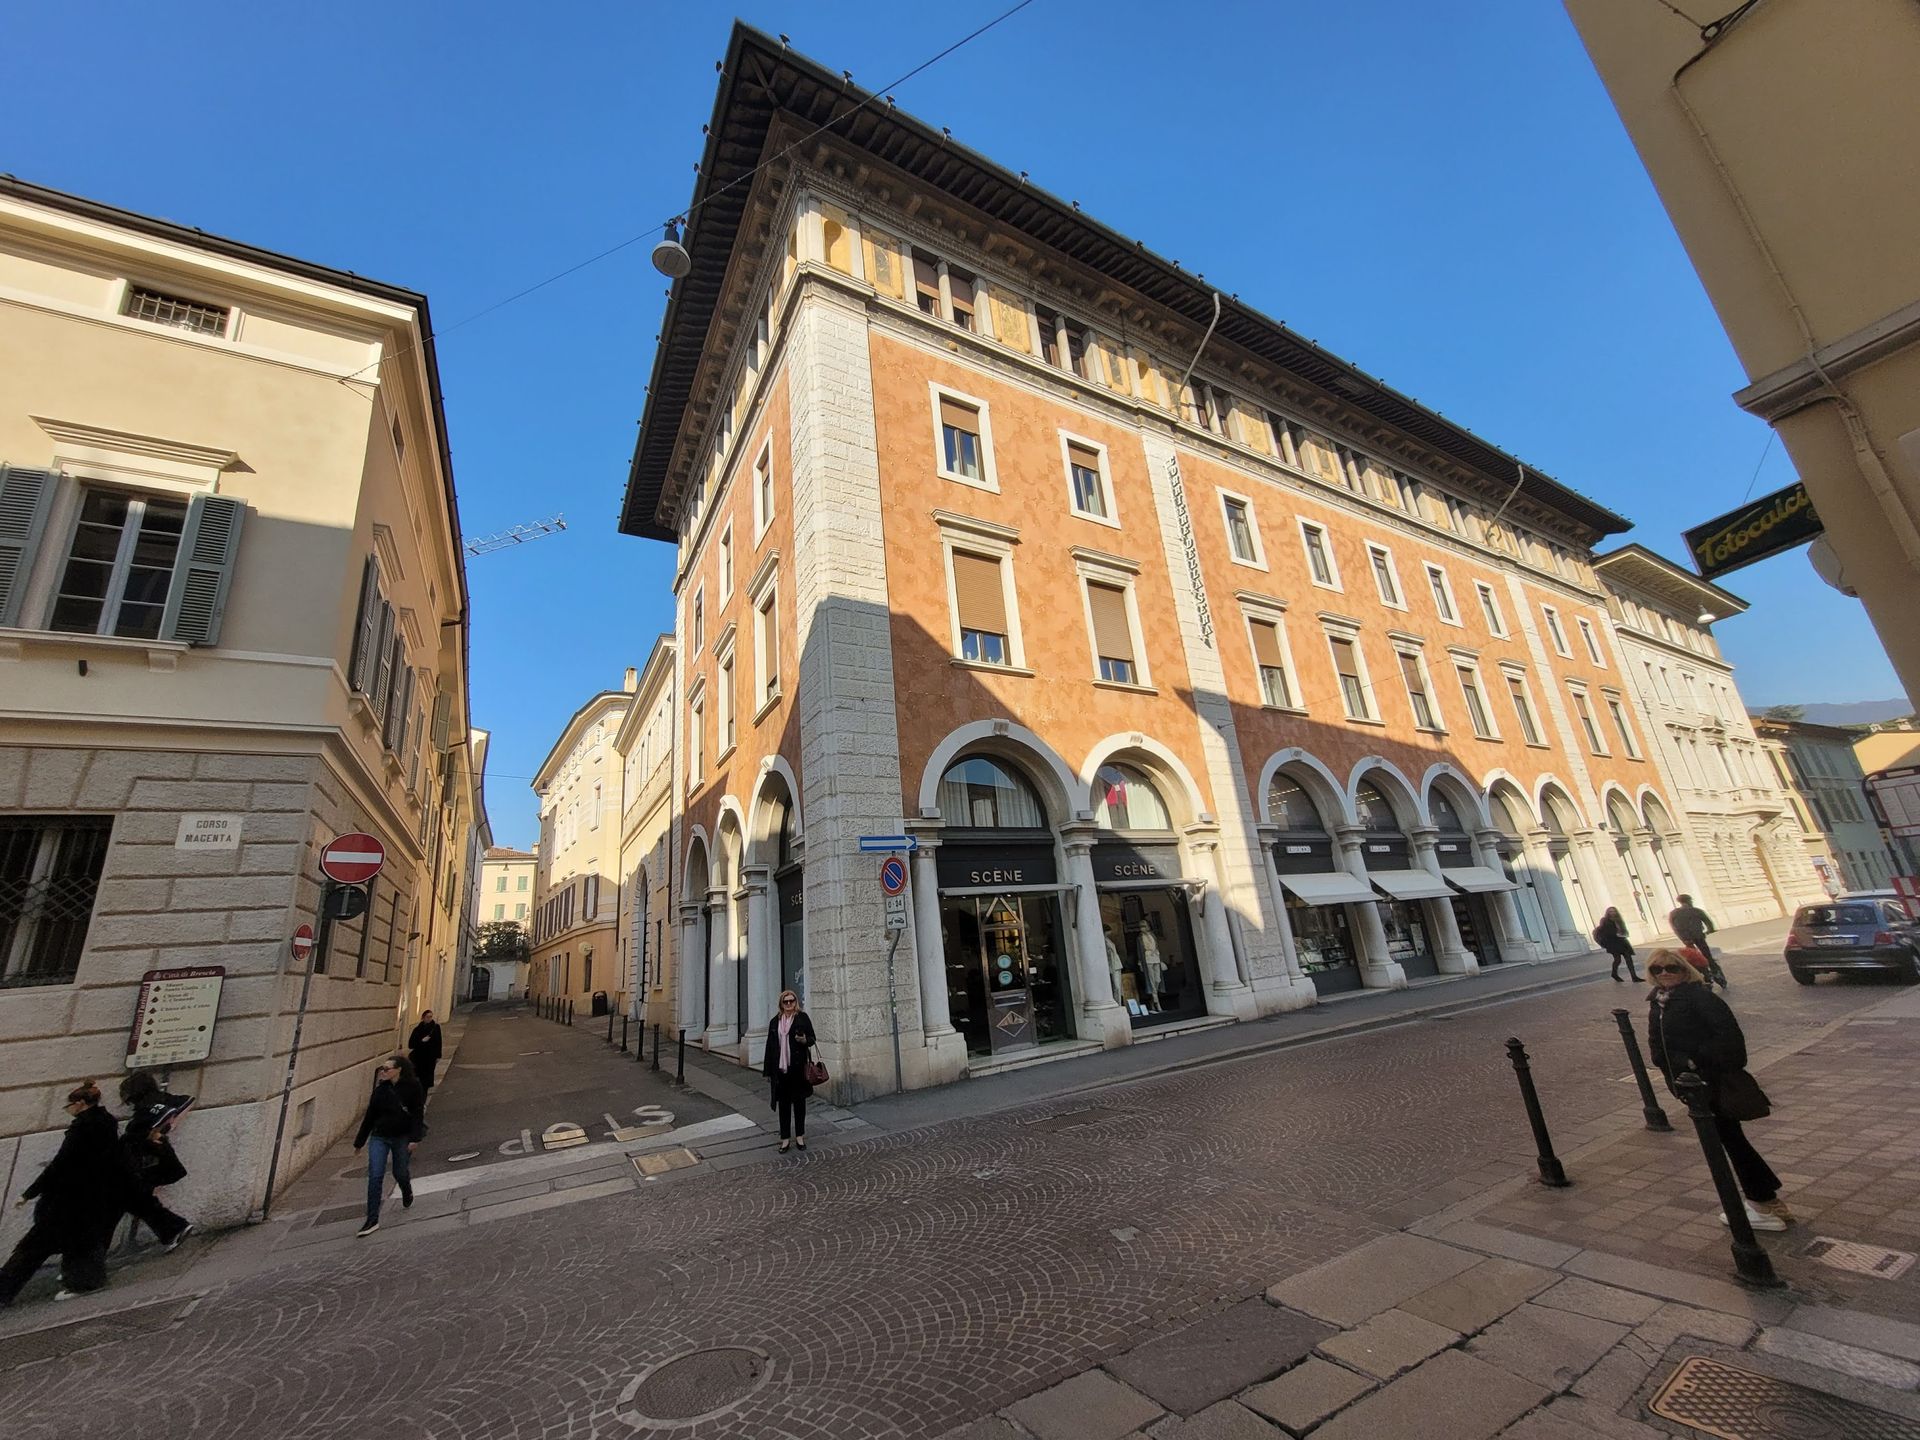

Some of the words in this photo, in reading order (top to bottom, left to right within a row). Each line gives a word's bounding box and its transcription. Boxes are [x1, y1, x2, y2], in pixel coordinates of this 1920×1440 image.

[1696, 485, 1810, 567] Totocalci
[1165, 455, 1191, 537] CORRIERE
[1183, 537, 1204, 592] DELLA
[1194, 592, 1214, 639] SERA
[196, 820, 228, 829] CORSO
[184, 833, 232, 843] MAGENTA
[970, 867, 1023, 884] SCÈNE
[1114, 861, 1156, 877] SCÈNE
[790, 890, 803, 906] SCÈ
